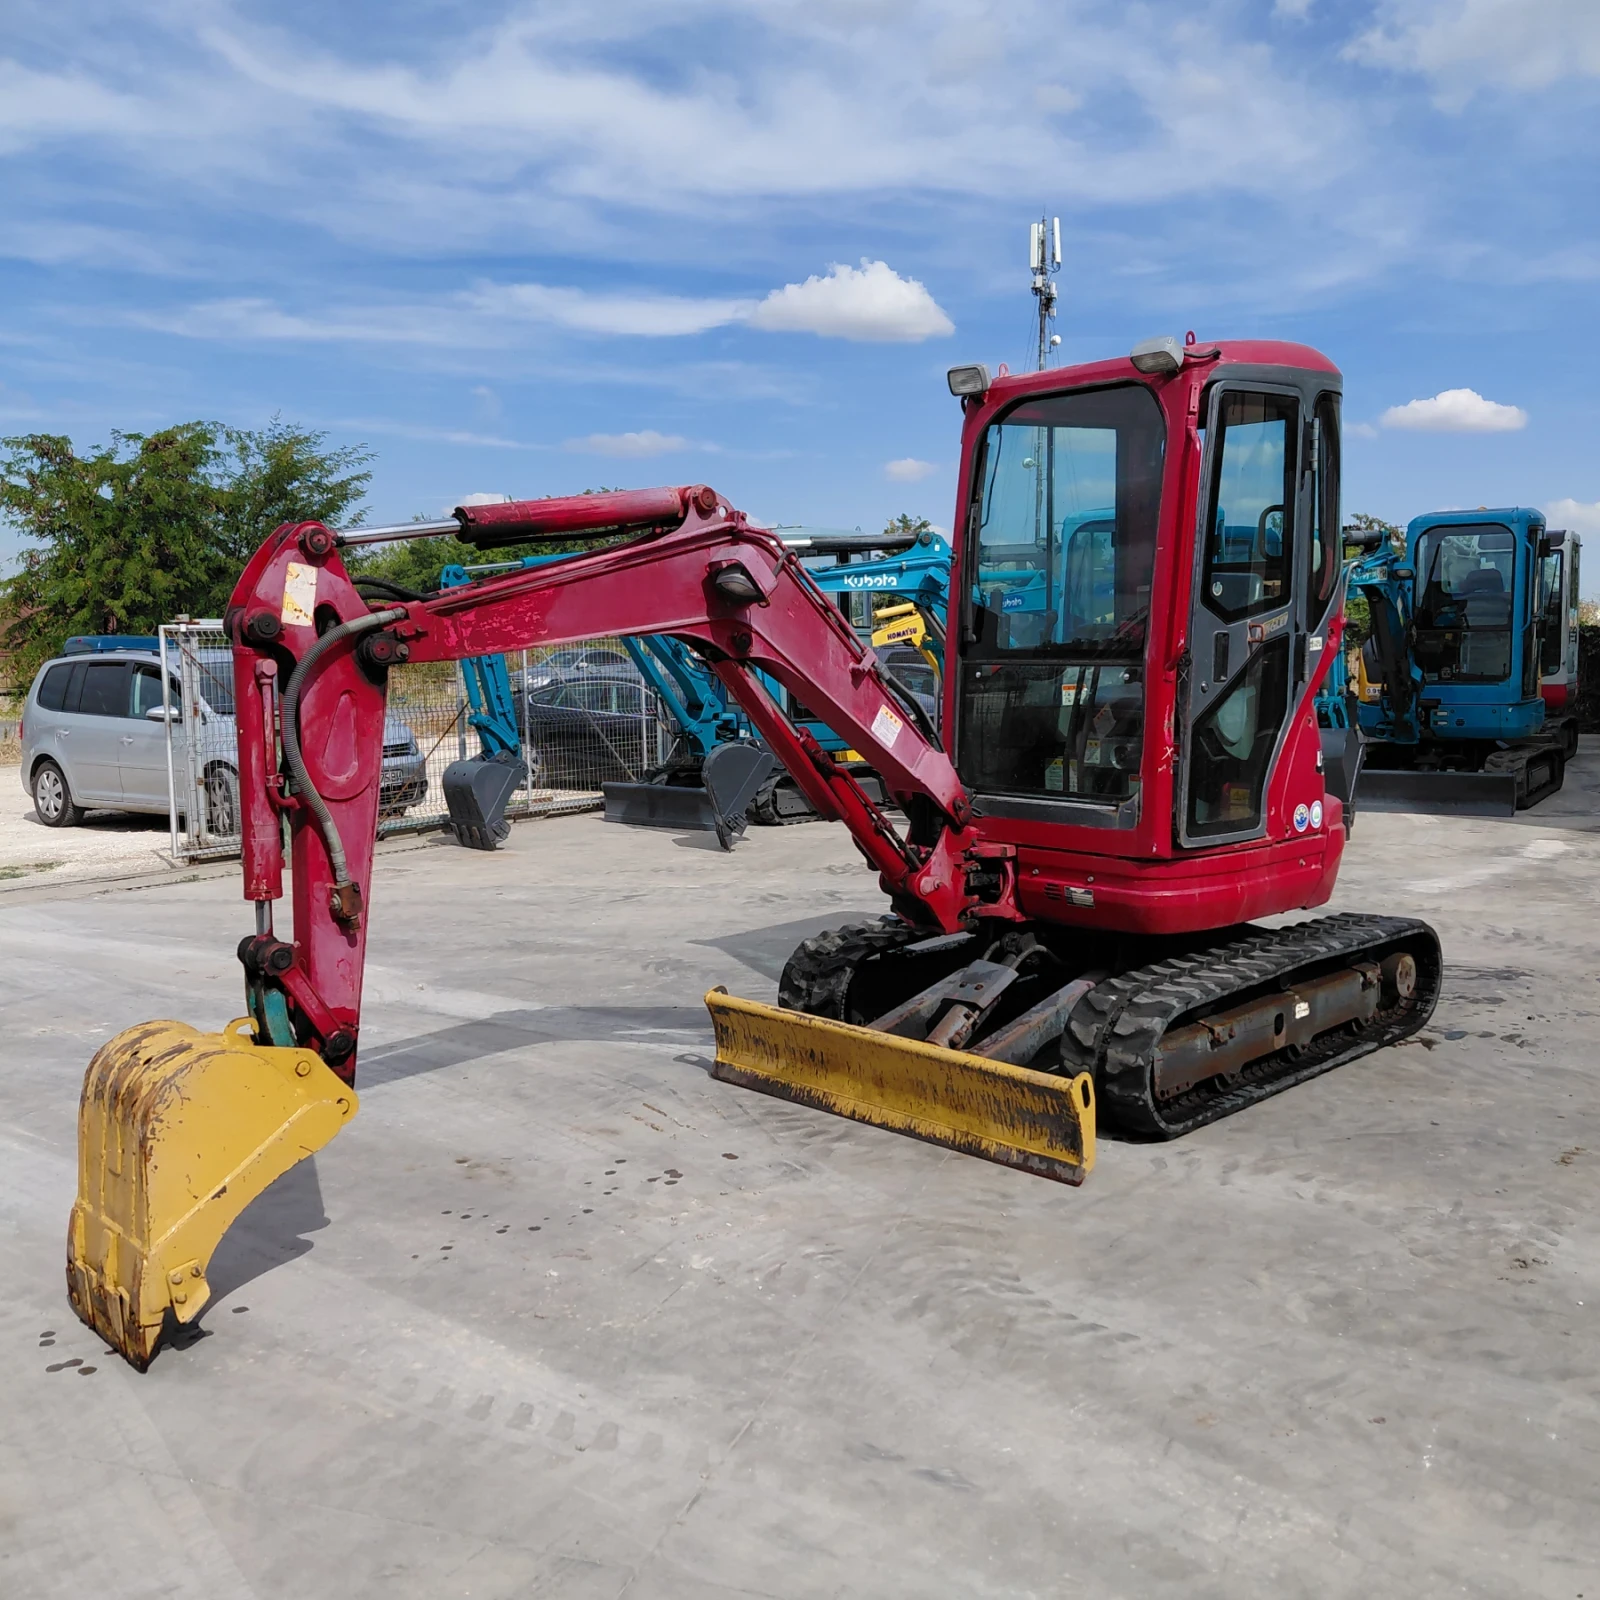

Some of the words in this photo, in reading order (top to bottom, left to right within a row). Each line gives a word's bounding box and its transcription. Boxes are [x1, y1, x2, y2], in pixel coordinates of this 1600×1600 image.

[844, 573, 897, 588] Kubota
[1002, 597, 1022, 608] ubota
[887, 627, 917, 640] KOMATSU
